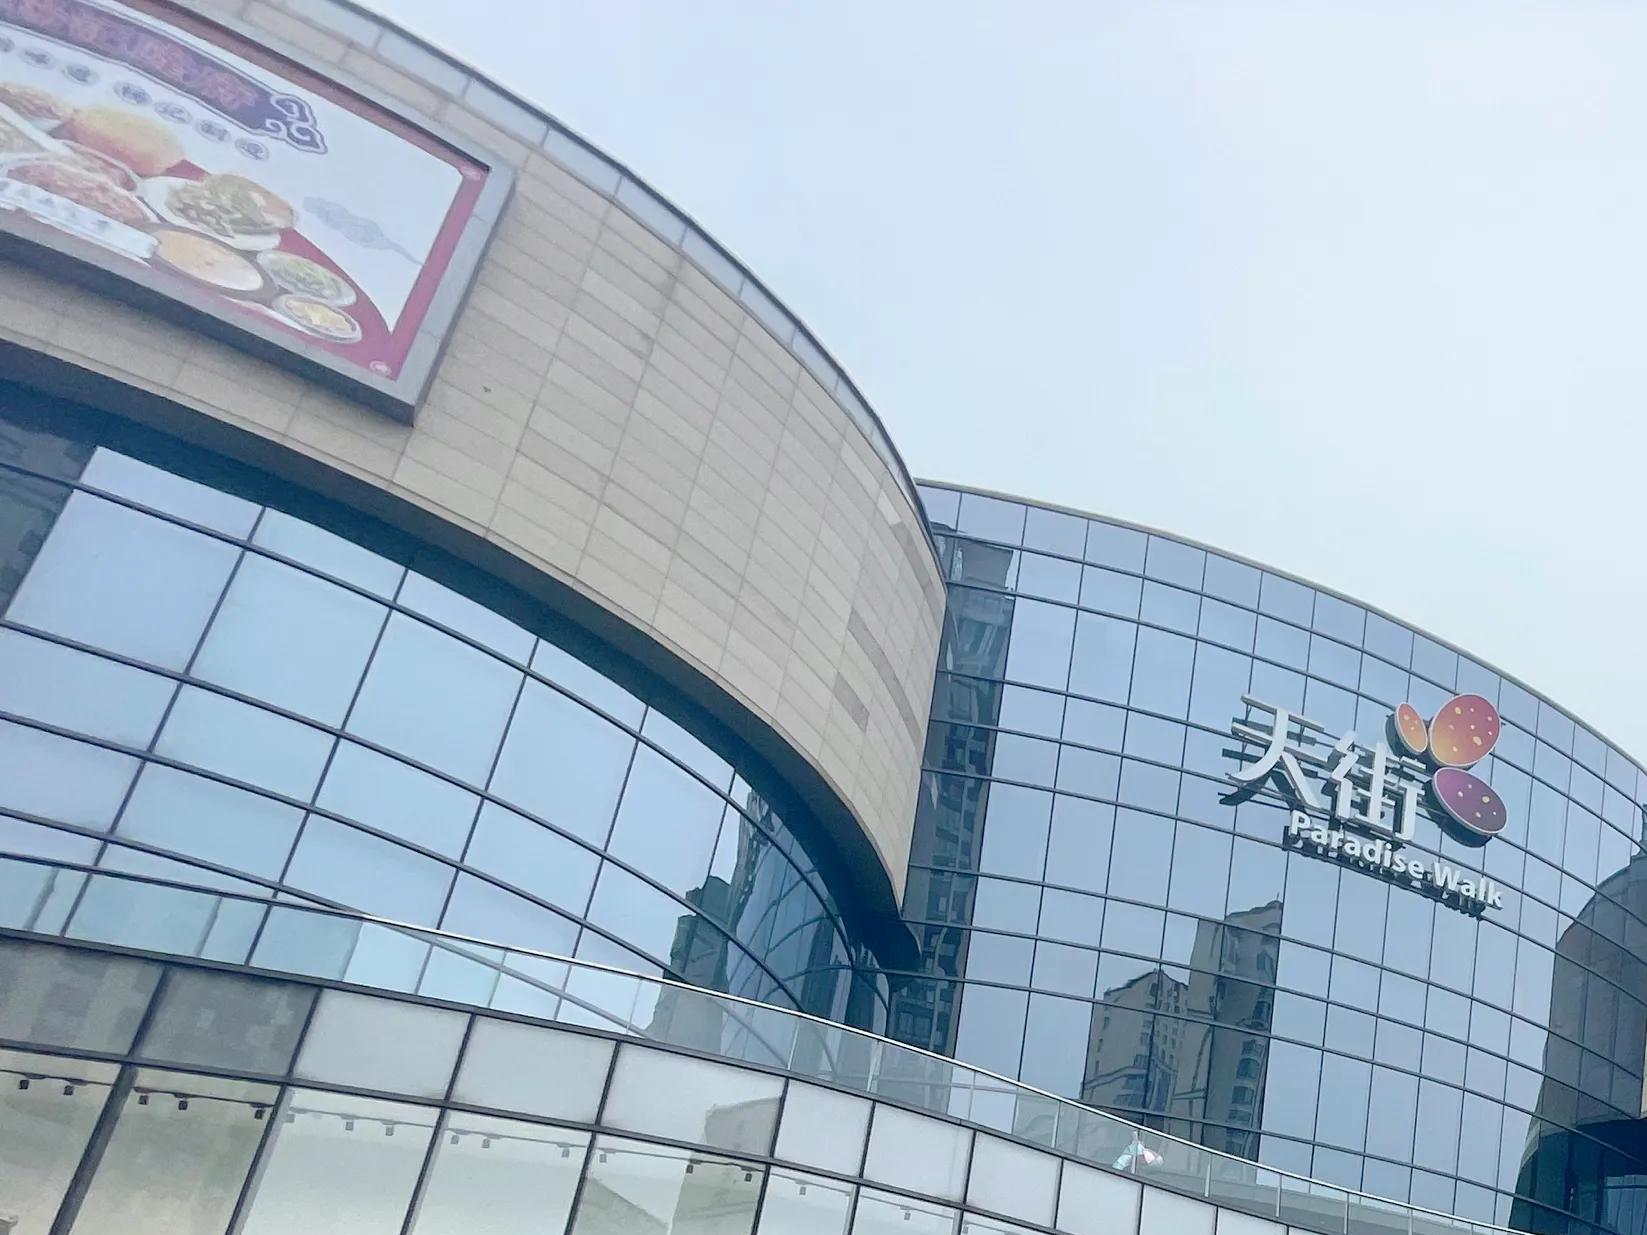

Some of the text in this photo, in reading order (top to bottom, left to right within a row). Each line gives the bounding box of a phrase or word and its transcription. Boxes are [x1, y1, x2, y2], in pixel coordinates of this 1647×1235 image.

[1225, 694, 1426, 841] 天街
[1289, 810, 1503, 909] Paradise Walk
